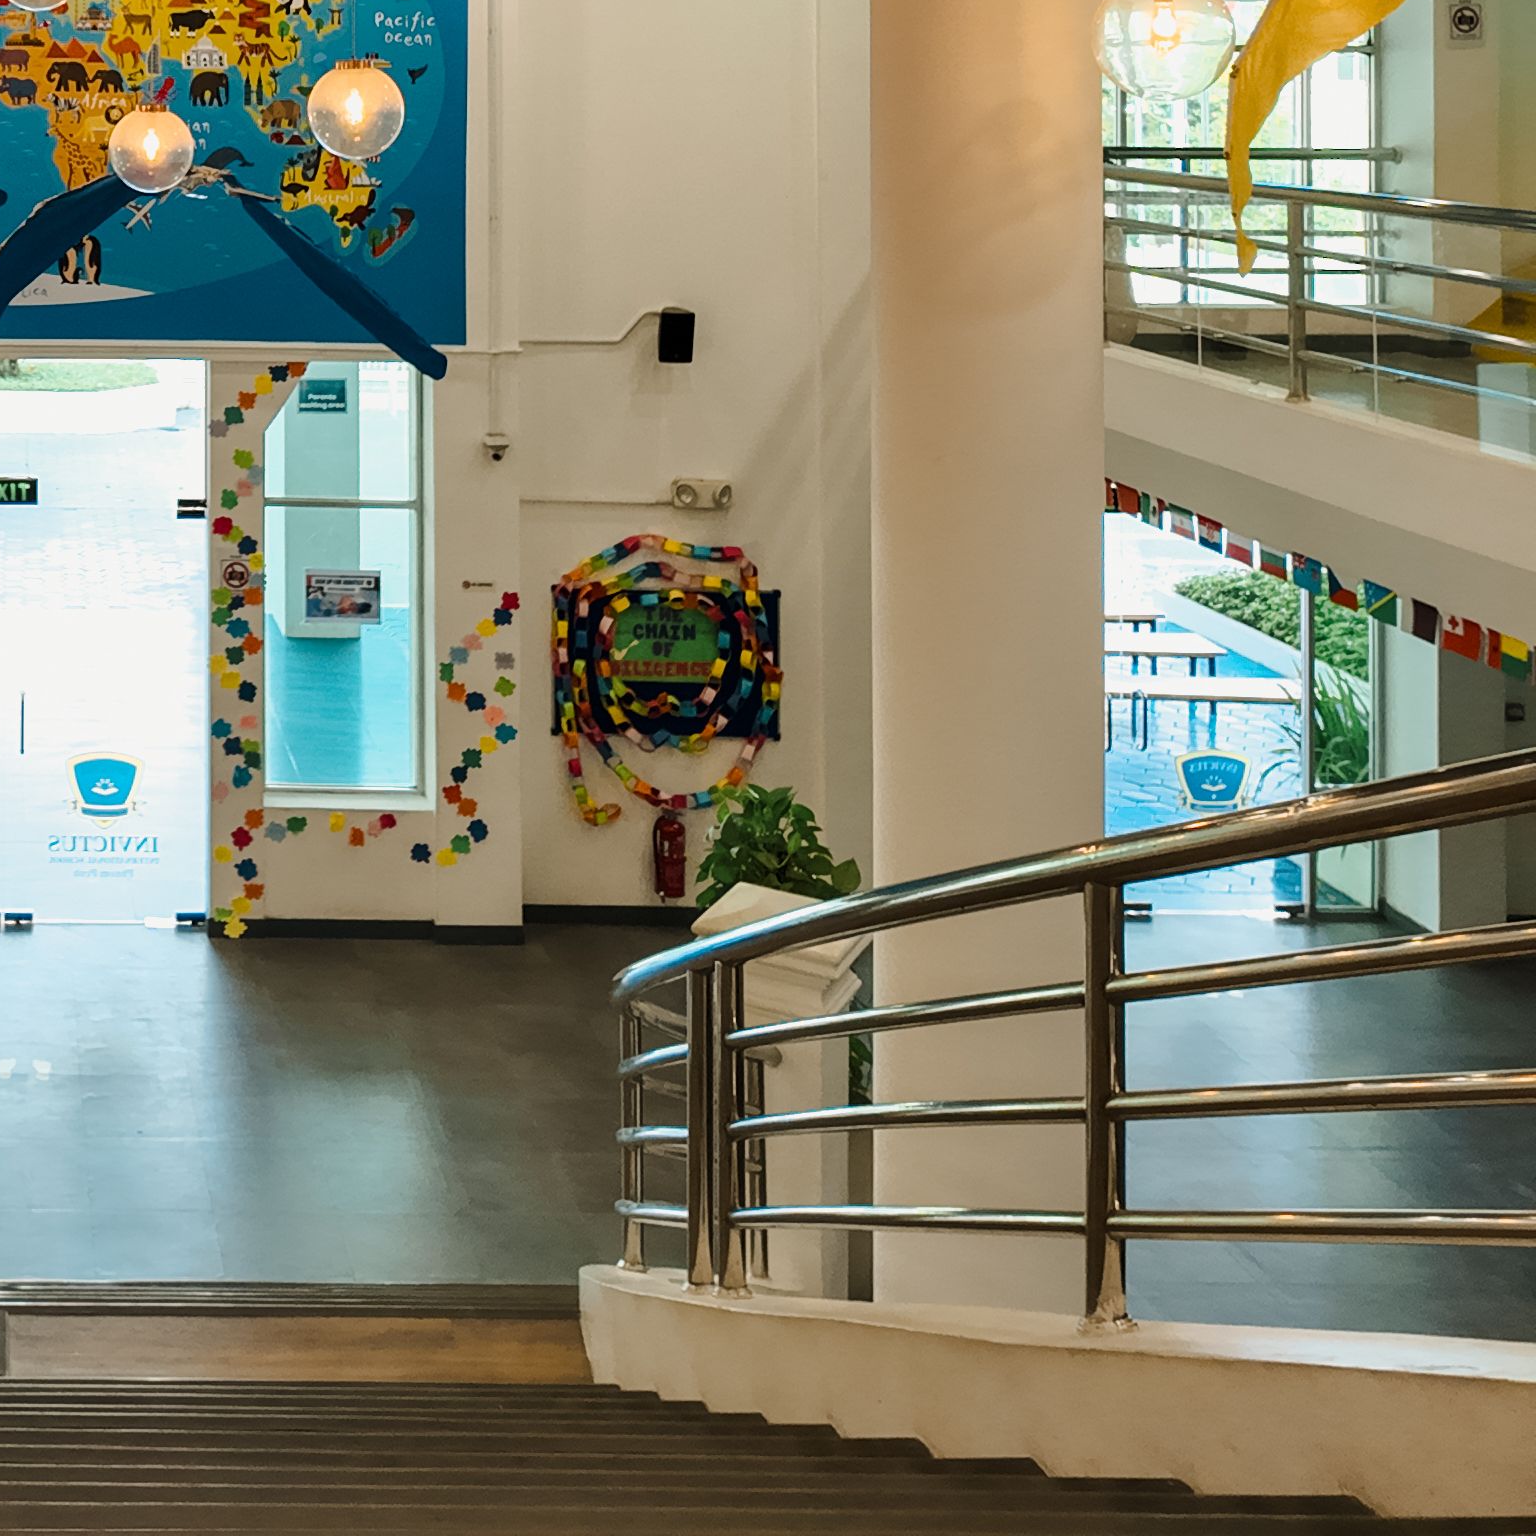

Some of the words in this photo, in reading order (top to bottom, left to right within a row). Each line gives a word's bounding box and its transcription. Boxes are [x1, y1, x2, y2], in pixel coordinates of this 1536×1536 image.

[374, 10, 436, 33] Pacific
[82, 92, 128, 110] Africa
[633, 623, 696, 641] CHAIN
[652, 640, 675, 657] OF
